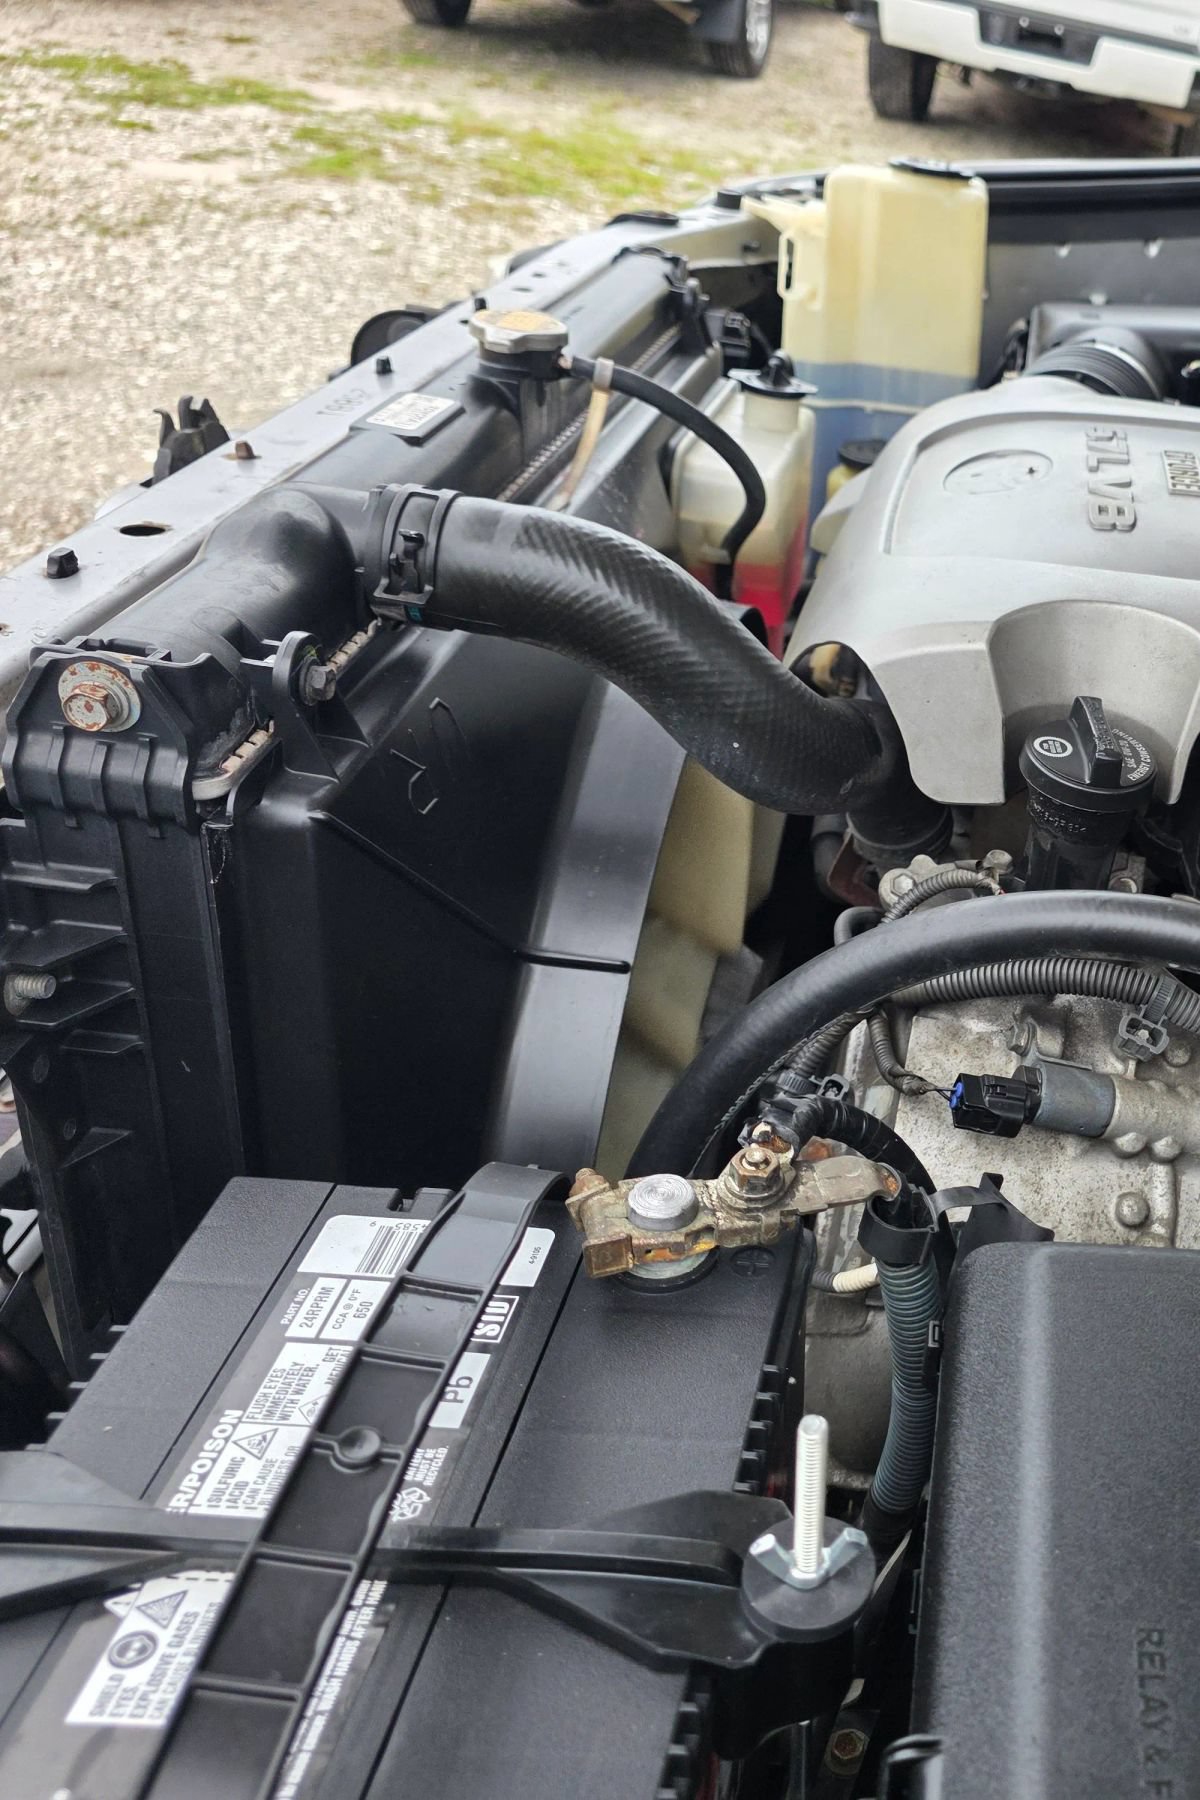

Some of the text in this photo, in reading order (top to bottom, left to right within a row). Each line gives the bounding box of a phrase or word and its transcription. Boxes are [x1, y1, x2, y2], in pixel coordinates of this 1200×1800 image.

[1088, 477, 1137, 532] V8
[299, 1286, 335, 1329] 24RPRM
[332, 1312, 346, 1330] CCA
[353, 1301, 374, 1319] 650
[246, 1367, 287, 1421] FLUSH EYES
[261, 1361, 305, 1421] IMMEDIATELY
[290, 1363, 321, 1397] WATER.
[440, 1375, 474, 1404] Pb
[165, 1409, 244, 1513] R/POISON
[208, 1456, 246, 1503] SULFURIC
[253, 1457, 279, 1487] CAUSE
[422, 1444, 450, 1486] RECYCLED.
[225, 1480, 250, 1505] ACID
[332, 1639, 362, 1677] HANDS
[350, 1606, 377, 1639] AFTER
[128, 1611, 201, 1719] EXPLOSIVE GASES
[1136, 1627, 1172, 1736] RELAY
[88, 1673, 126, 1718] SHIELD
